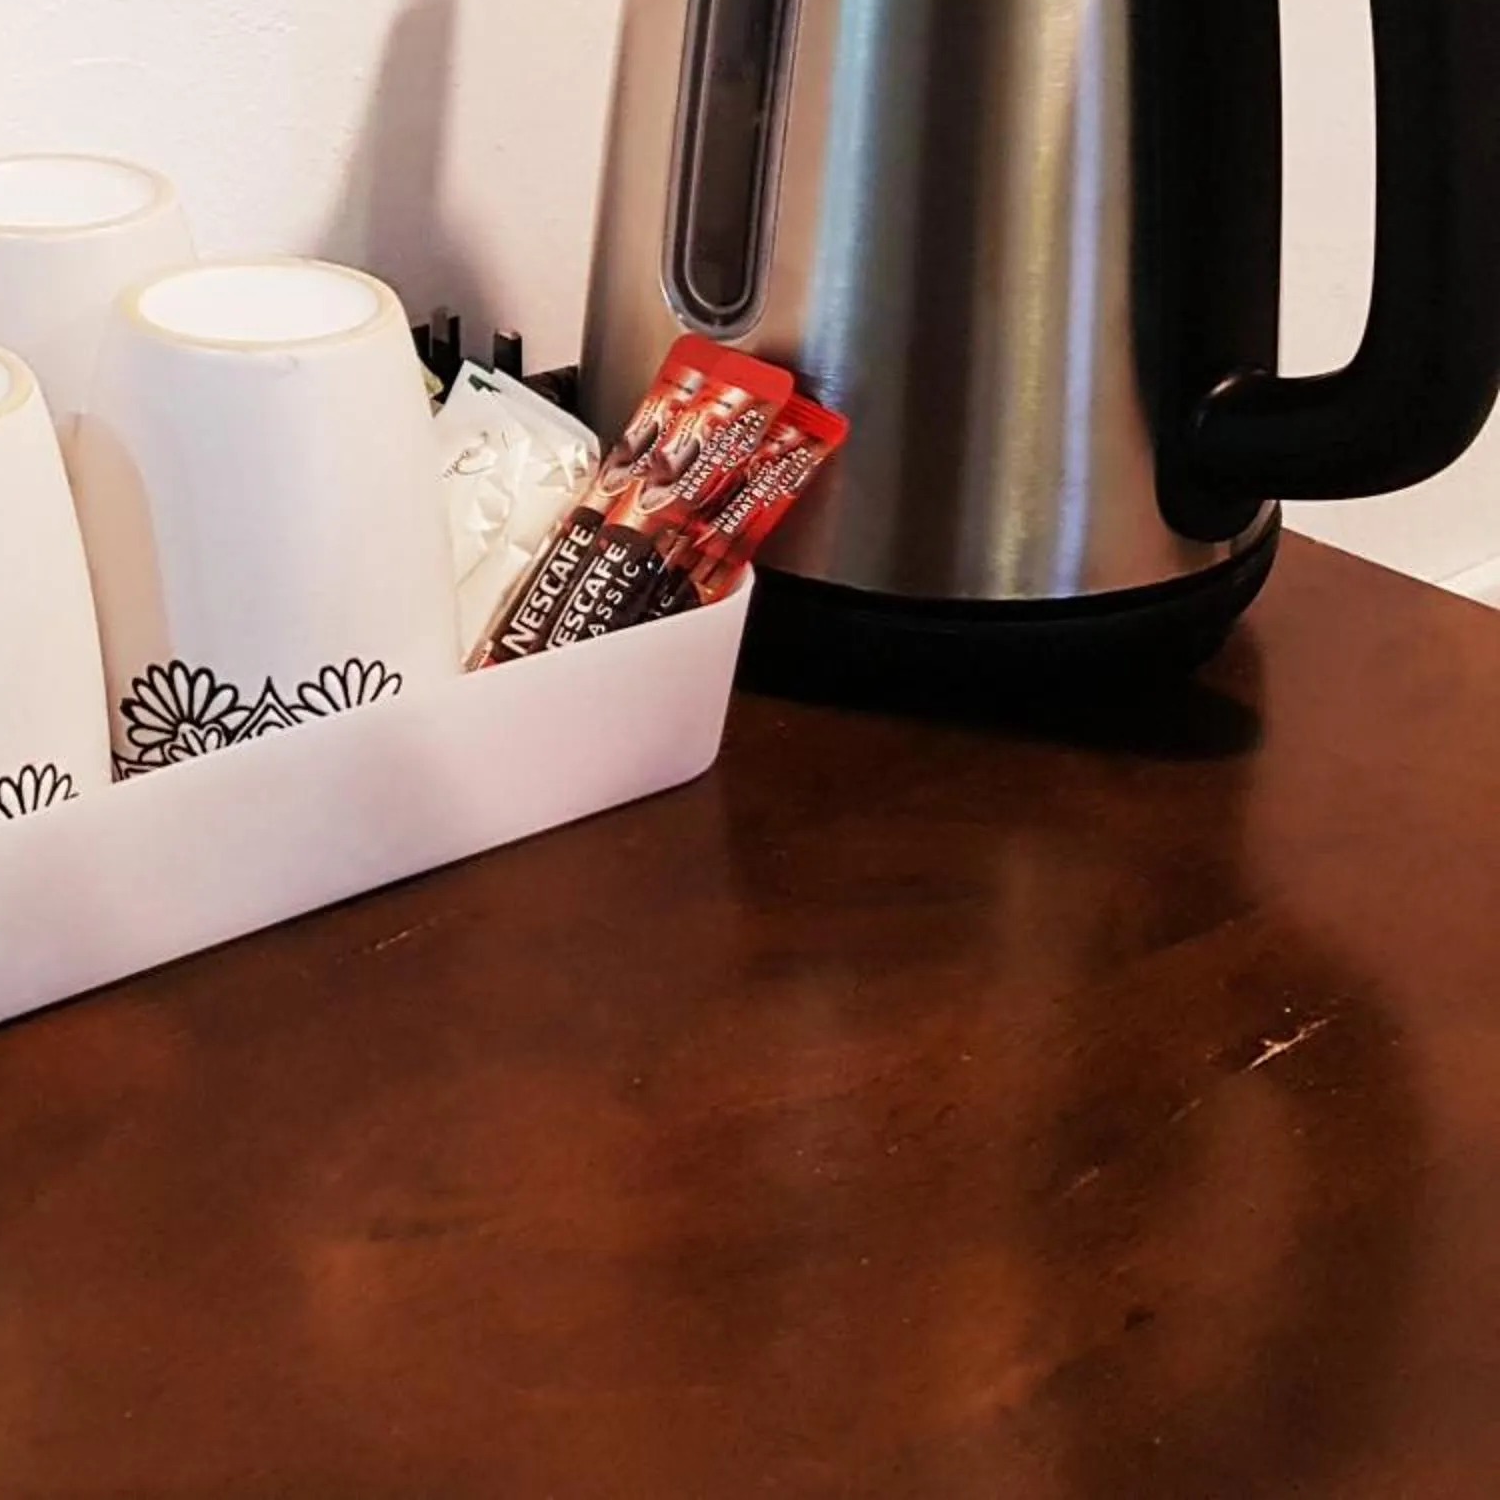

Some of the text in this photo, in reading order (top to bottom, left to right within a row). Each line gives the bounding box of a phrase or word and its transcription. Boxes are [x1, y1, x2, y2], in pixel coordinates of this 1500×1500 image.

[682, 463, 713, 501] BERAT
[710, 422, 744, 465] BERSIH
[722, 496, 754, 534] BERAT
[752, 456, 790, 498] BERSIH
[588, 561, 640, 638] ASSIC
